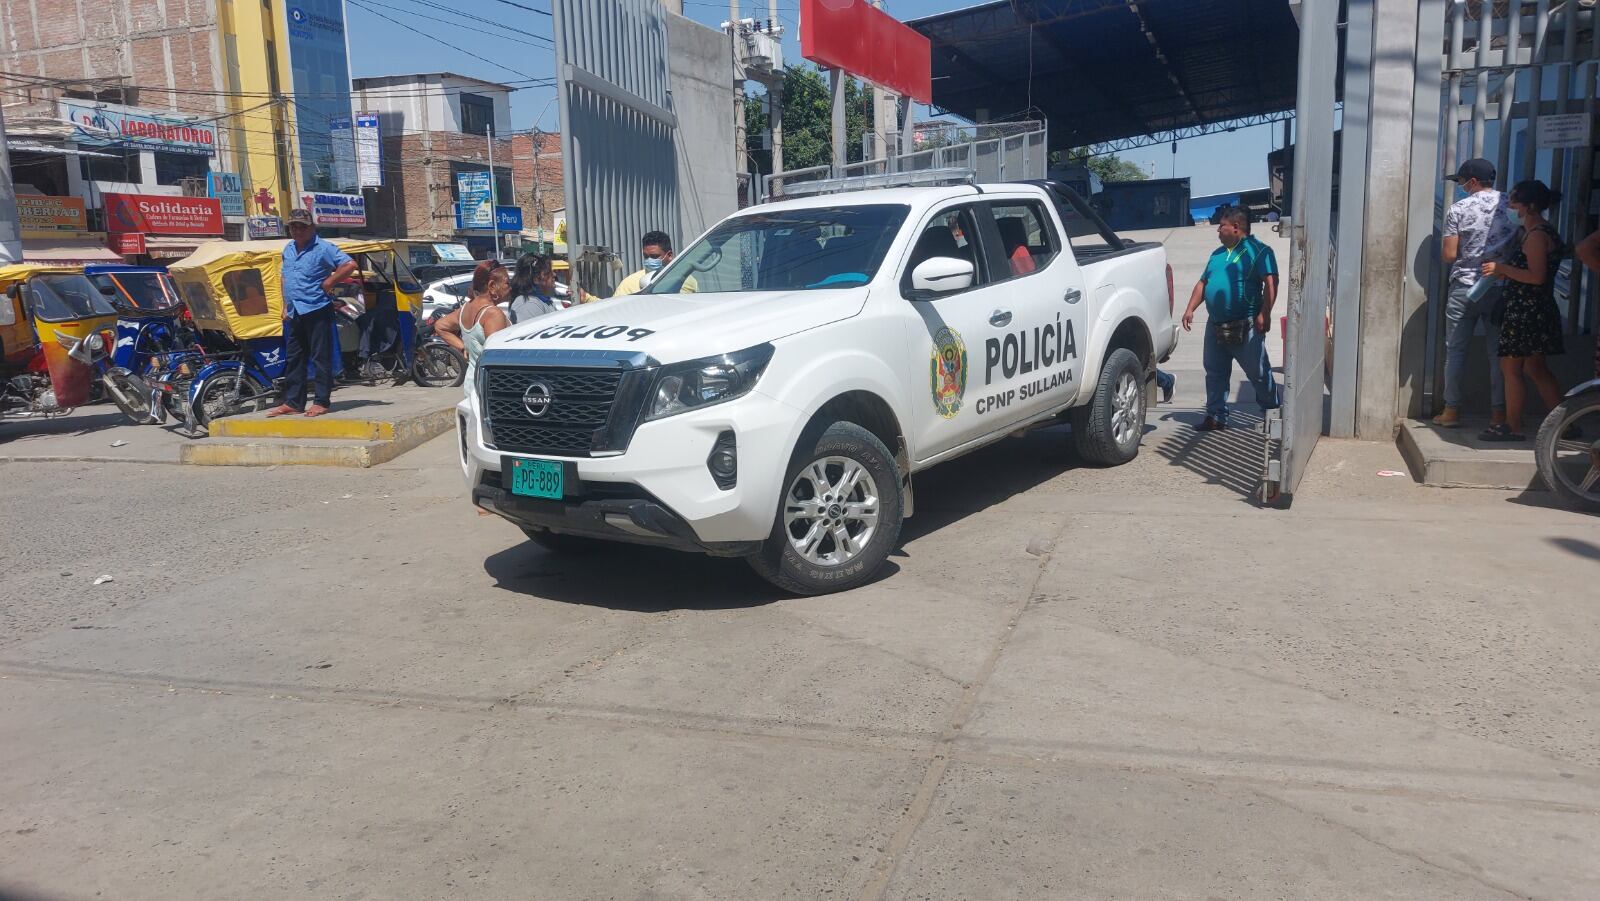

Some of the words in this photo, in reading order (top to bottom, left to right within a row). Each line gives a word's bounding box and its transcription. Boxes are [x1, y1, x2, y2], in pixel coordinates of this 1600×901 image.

[121, 119, 213, 145] LABORATORIO
[17, 206, 80, 217] IBERTAD
[139, 201, 213, 215] Solidaria
[985, 312, 1078, 385] POLICÍA
[976, 389, 1015, 415] CPNP
[1019, 368, 1073, 401] SULLANA
